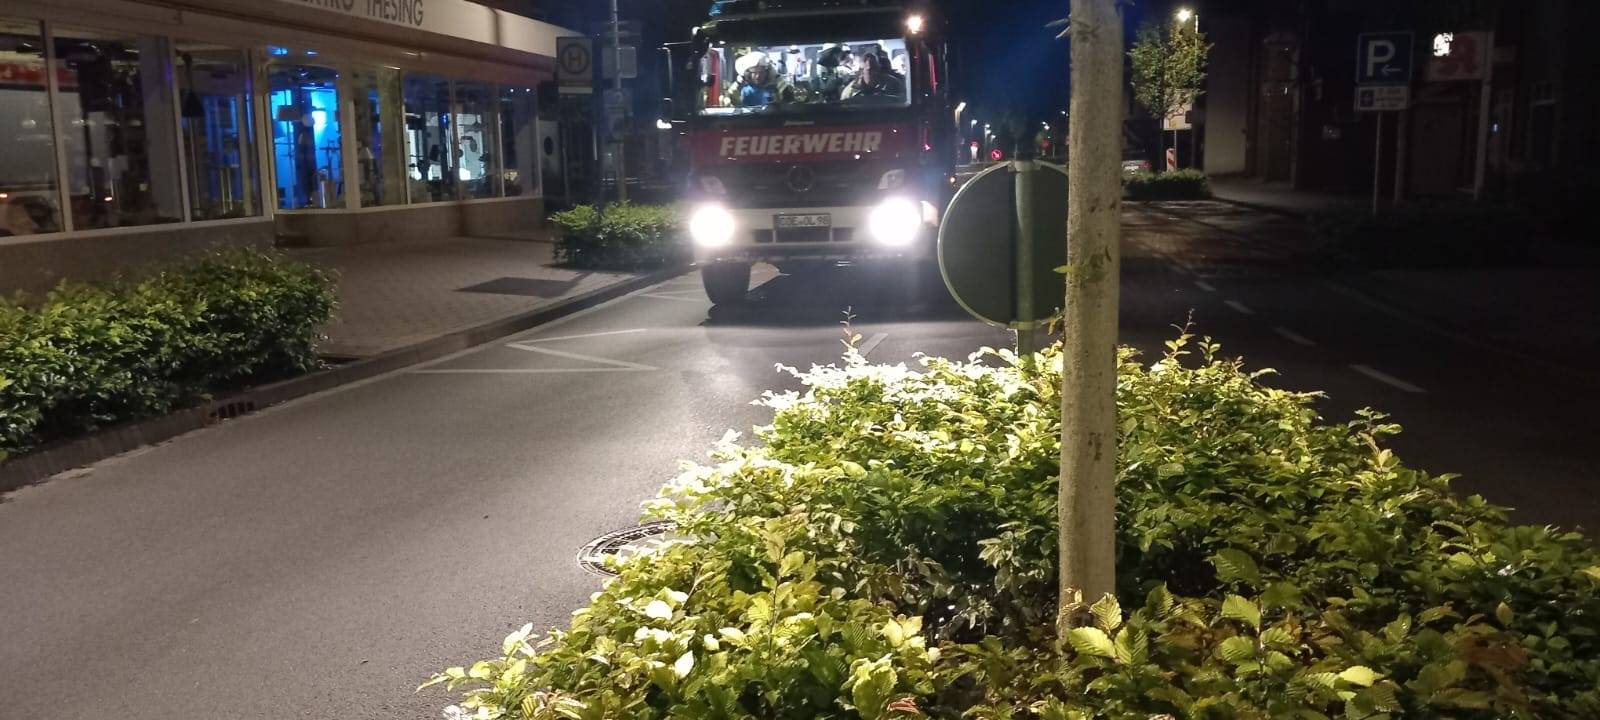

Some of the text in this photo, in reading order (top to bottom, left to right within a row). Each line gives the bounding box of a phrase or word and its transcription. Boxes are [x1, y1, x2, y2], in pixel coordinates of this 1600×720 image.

[568, 50, 582, 66] H
[1366, 40, 1396, 77] P
[720, 131, 882, 156] FEUERWEHR
